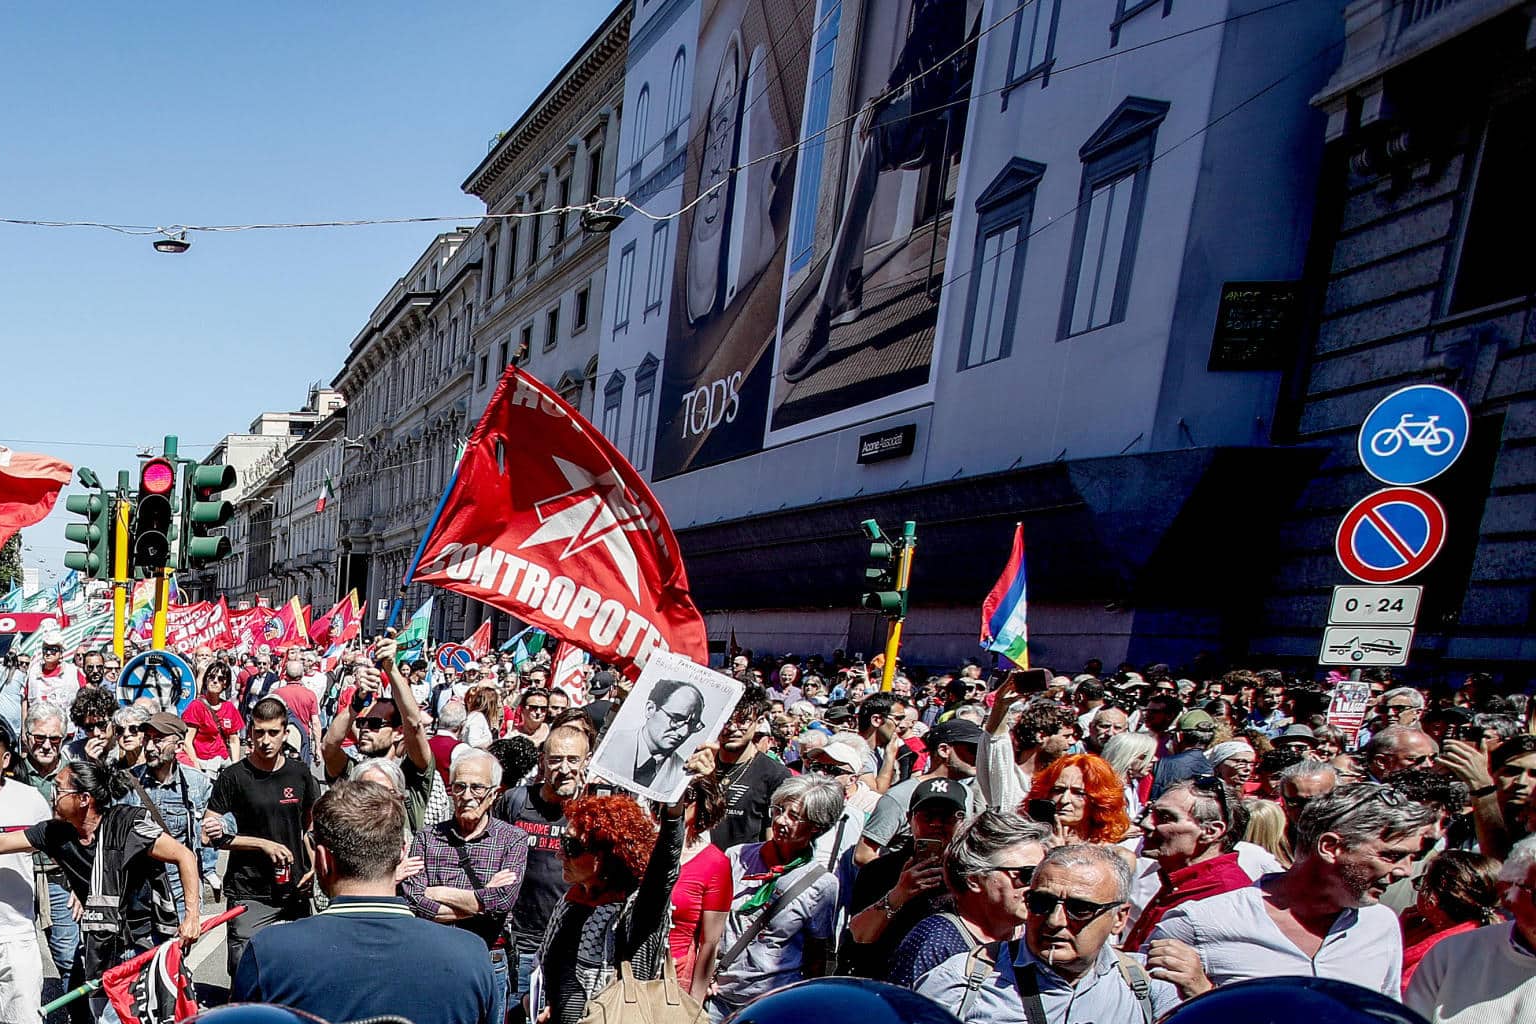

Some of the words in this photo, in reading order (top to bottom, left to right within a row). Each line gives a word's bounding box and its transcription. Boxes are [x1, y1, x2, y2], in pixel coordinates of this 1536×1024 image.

[681, 370, 742, 439] TOD'S
[1345, 598, 1358, 612] 0
[1377, 598, 1404, 612] 24
[930, 780, 949, 793] NY
